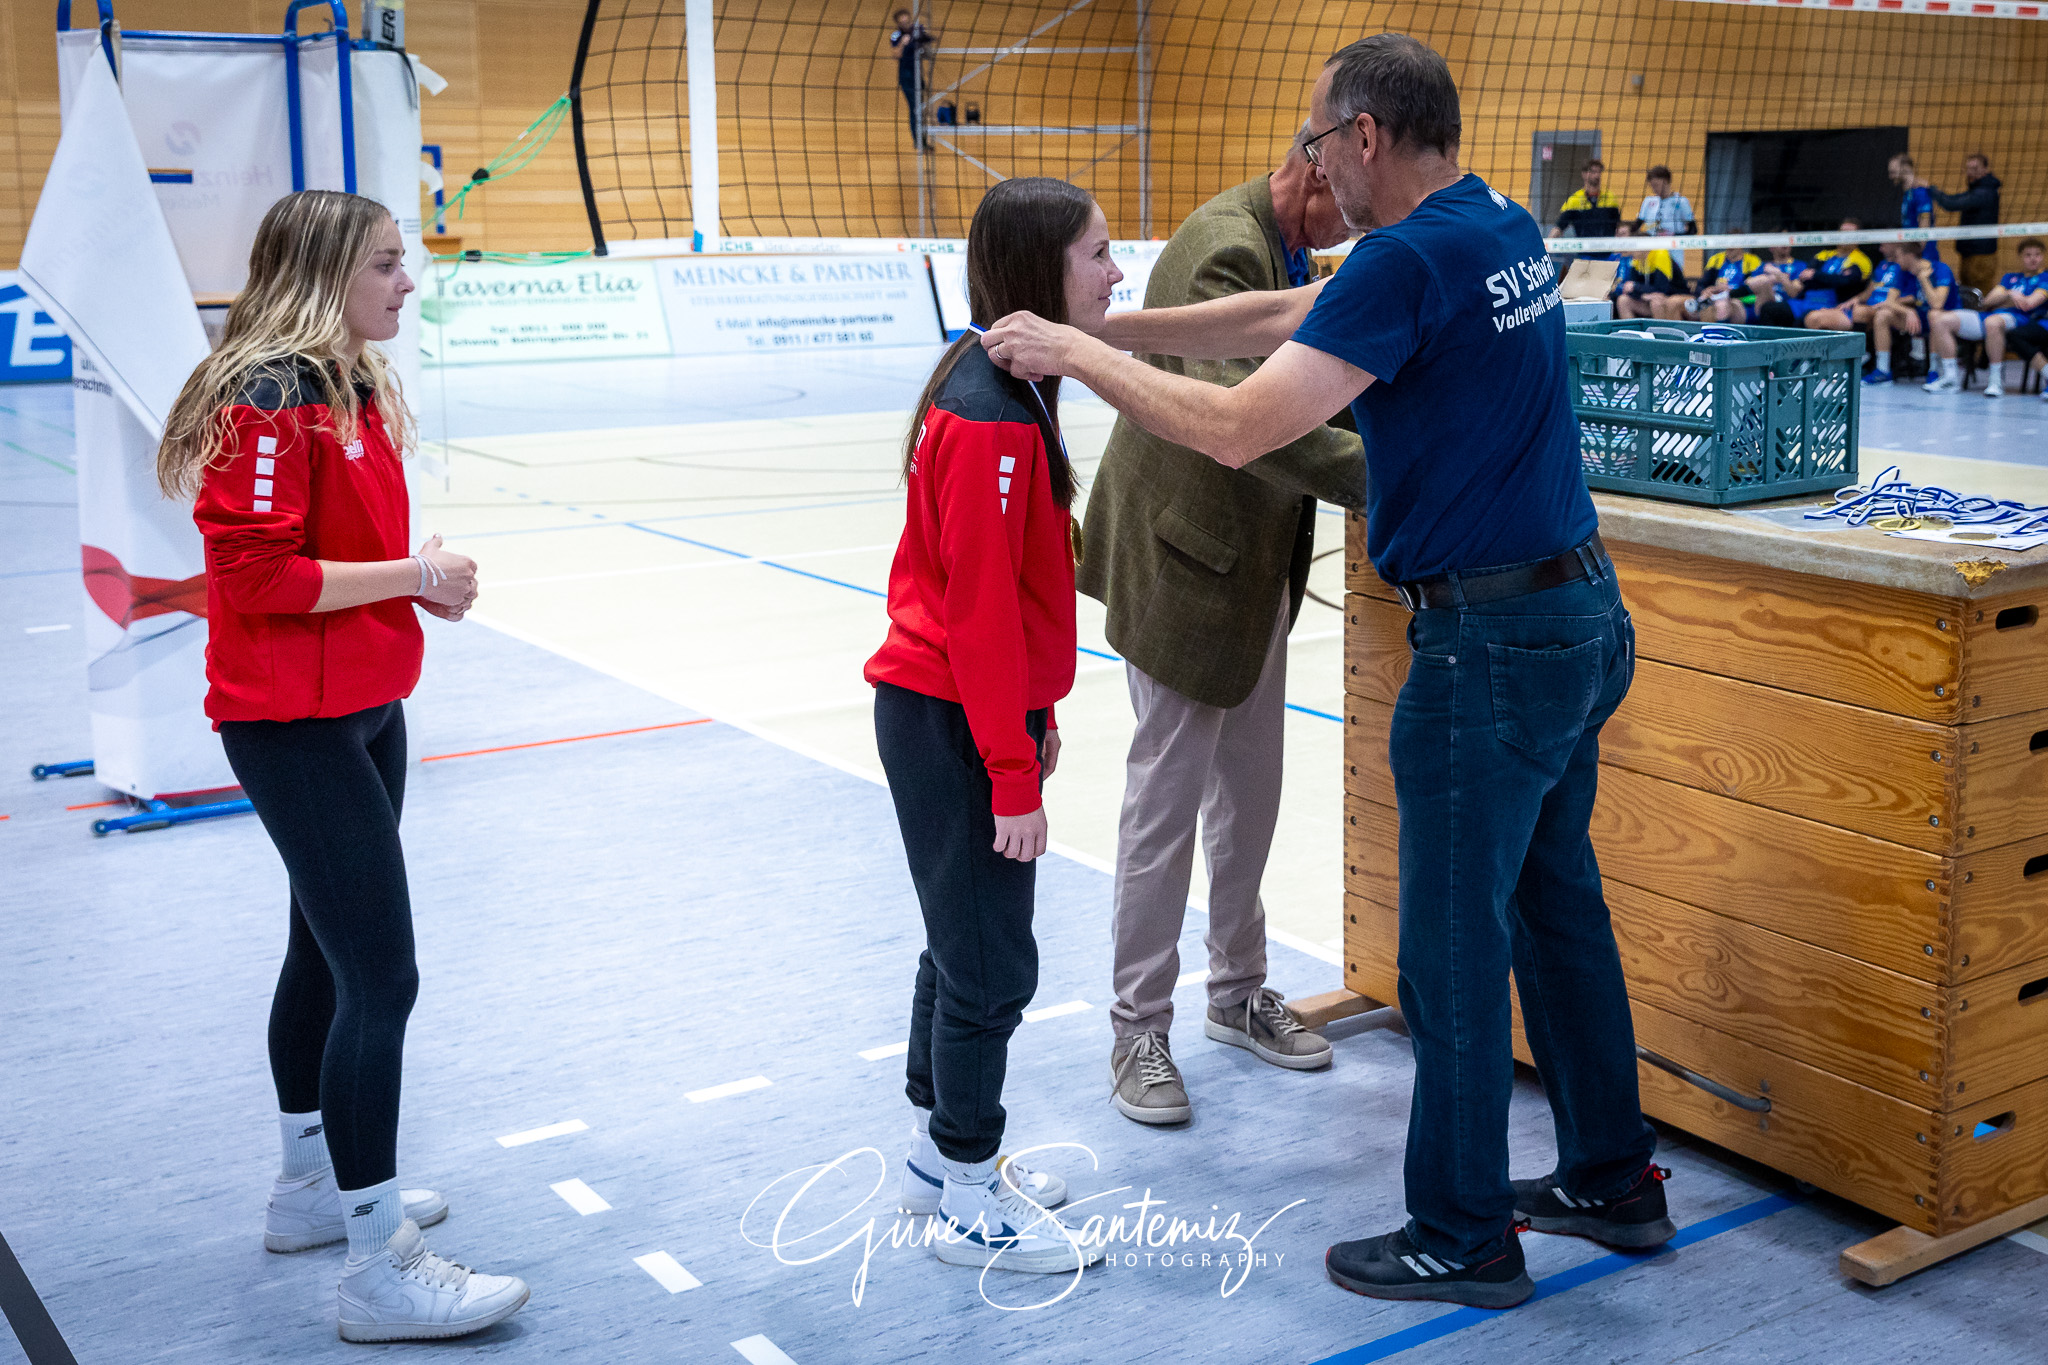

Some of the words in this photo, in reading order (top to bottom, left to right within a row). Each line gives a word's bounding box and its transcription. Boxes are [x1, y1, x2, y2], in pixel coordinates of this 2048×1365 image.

[911, 243, 955, 252] FUCHS
[435, 276, 574, 299] Taverna
[577, 271, 644, 294] Elia
[673, 265, 786, 288] MEINCKE
[790, 265, 808, 284] &
[813, 261, 914, 285] PARTNER
[1485, 266, 1521, 328] SV
[756, 312, 896, 330] info@meincke-partner.de
[1492, 296, 1546, 333] Volleyball
